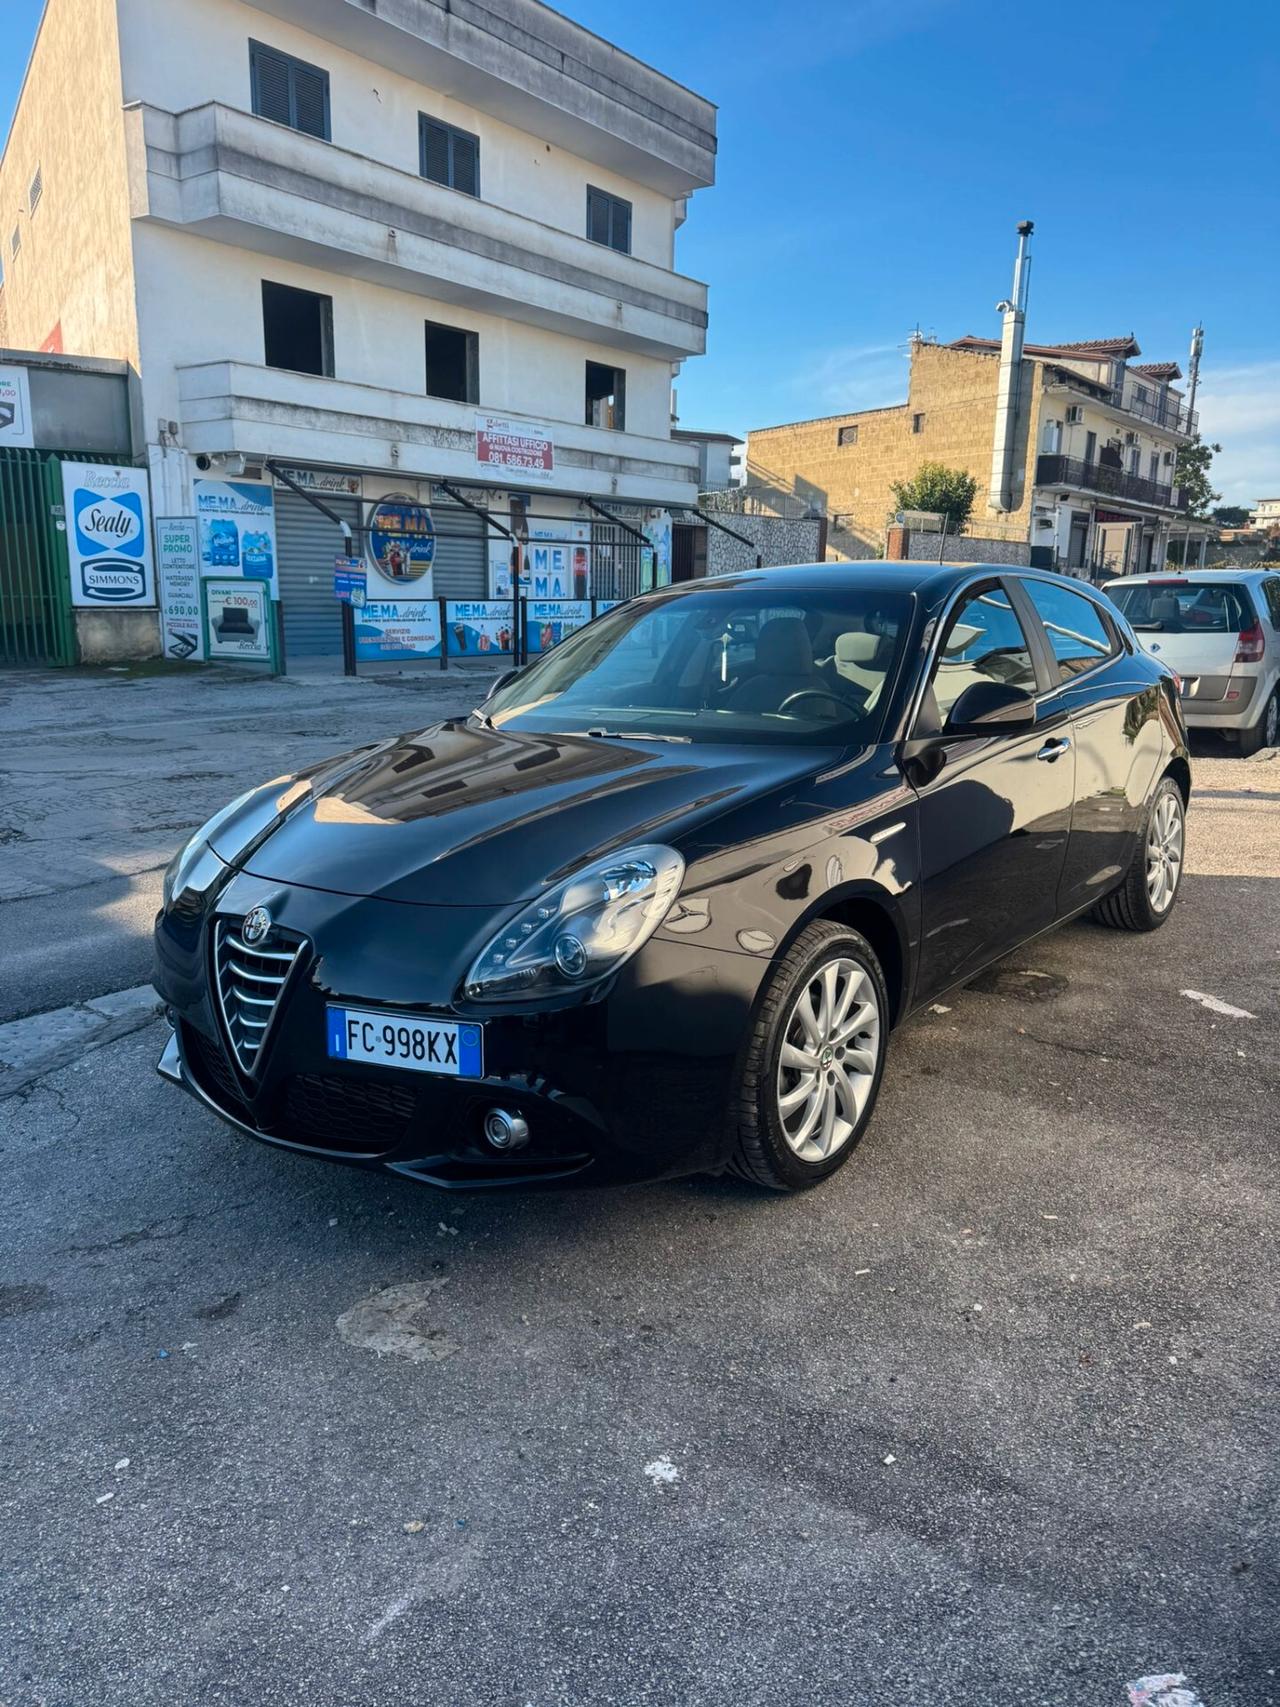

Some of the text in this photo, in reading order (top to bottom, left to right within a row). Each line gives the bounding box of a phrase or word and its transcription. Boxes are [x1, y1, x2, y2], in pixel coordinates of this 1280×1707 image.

[482, 432, 548, 451] AFFITTASI UFFICIO
[495, 444, 511, 453] NUOVA
[512, 447, 543, 457] COSTRUZIONE
[85, 508, 131, 538] Sealy
[163, 534, 191, 544] SUPER
[163, 544, 193, 553] PROMO
[88, 574, 140, 585] SIMMONS
[168, 605, 199, 616] 690,00
